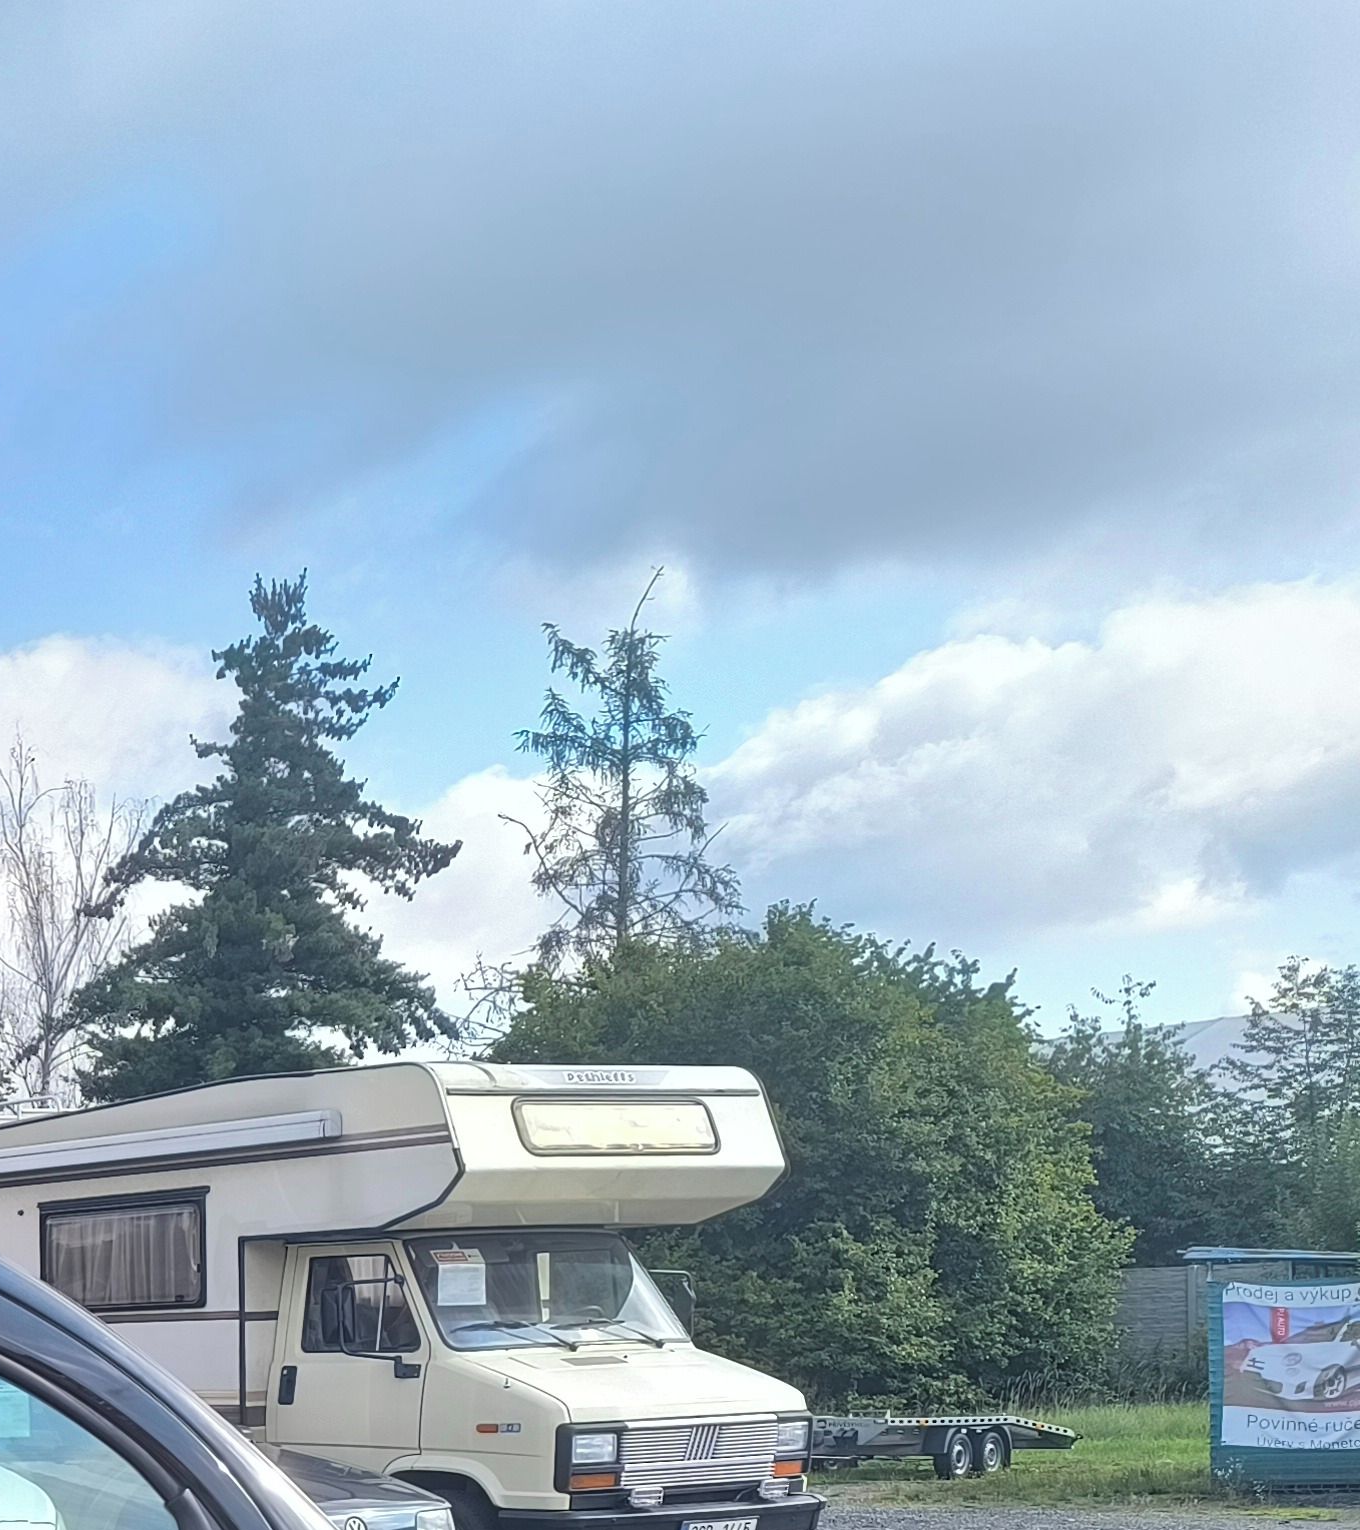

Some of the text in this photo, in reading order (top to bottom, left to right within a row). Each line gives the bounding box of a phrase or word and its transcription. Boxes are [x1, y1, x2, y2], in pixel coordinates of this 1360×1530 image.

[1284, 1291, 1294, 1301] a
[1300, 1287, 1352, 1304] výkup
[1246, 1414, 1318, 1433] Povinné
